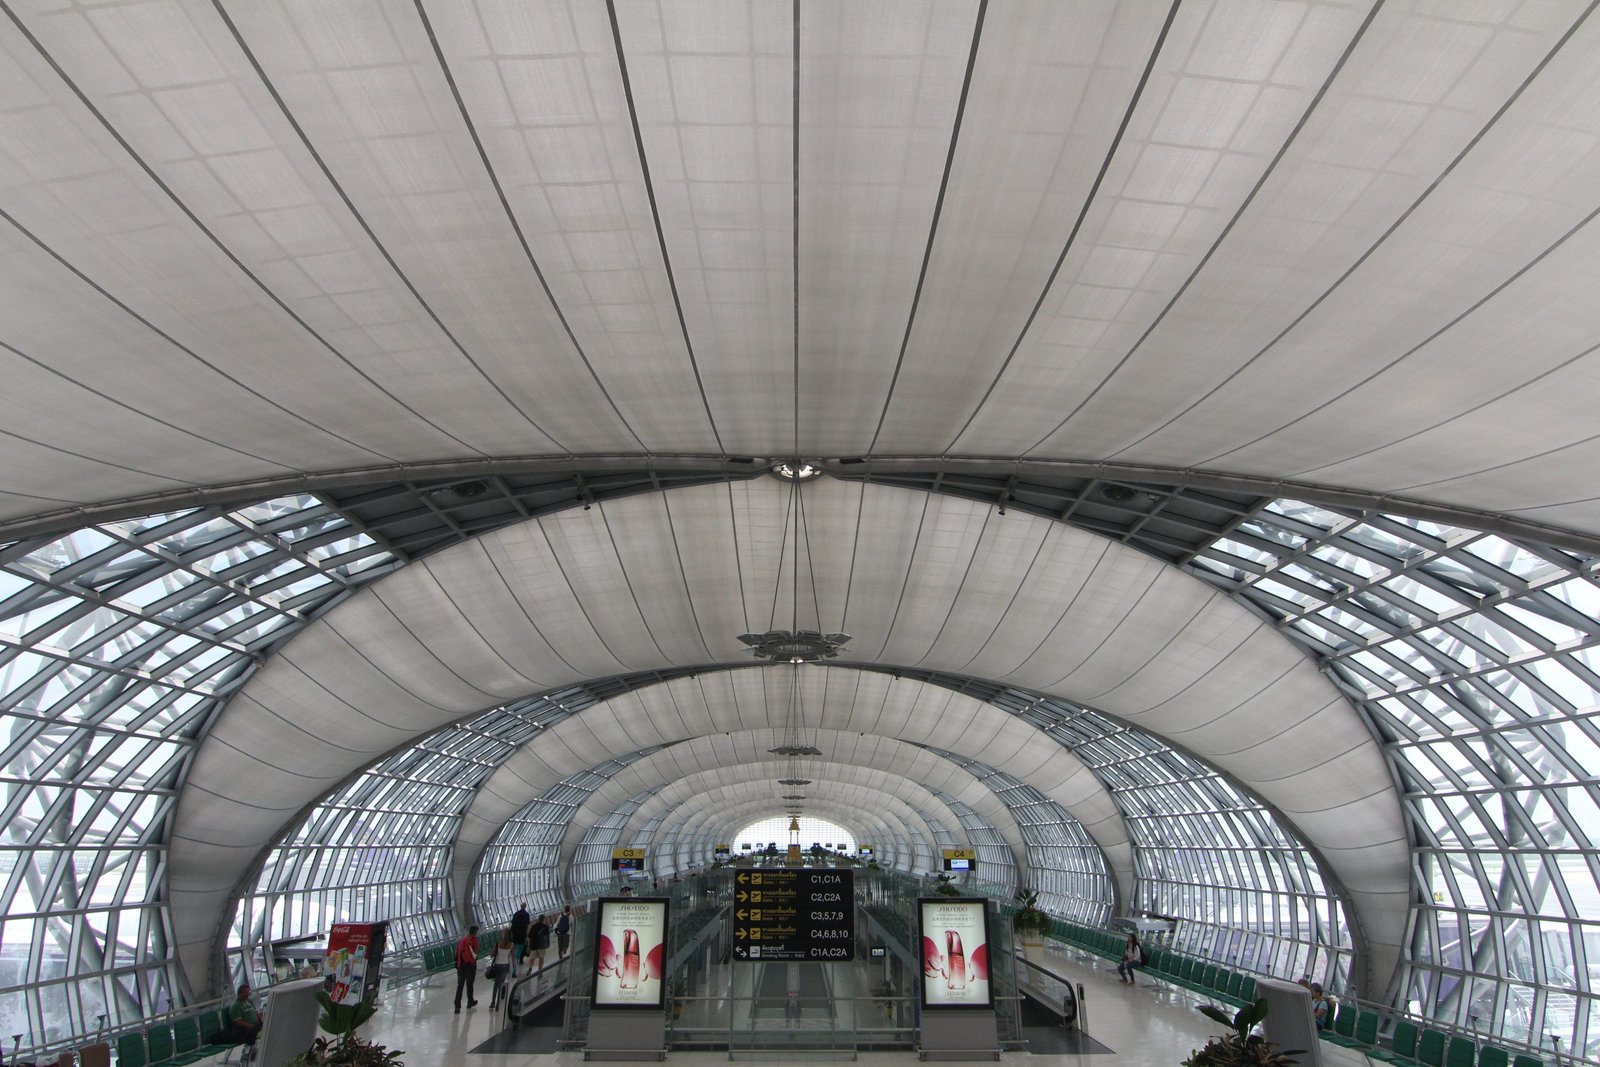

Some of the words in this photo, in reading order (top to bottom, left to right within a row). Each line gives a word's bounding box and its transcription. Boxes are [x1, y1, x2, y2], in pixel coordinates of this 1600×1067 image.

[623, 849, 634, 857] C3
[953, 850, 965, 858] C4
[811, 875, 841, 884] C1,C1A
[811, 893, 841, 902] C2,C2A
[811, 912, 844, 921] C3,5,7,9
[811, 930, 849, 939] C4,6,8,10
[811, 948, 847, 957] C1A,C2A
